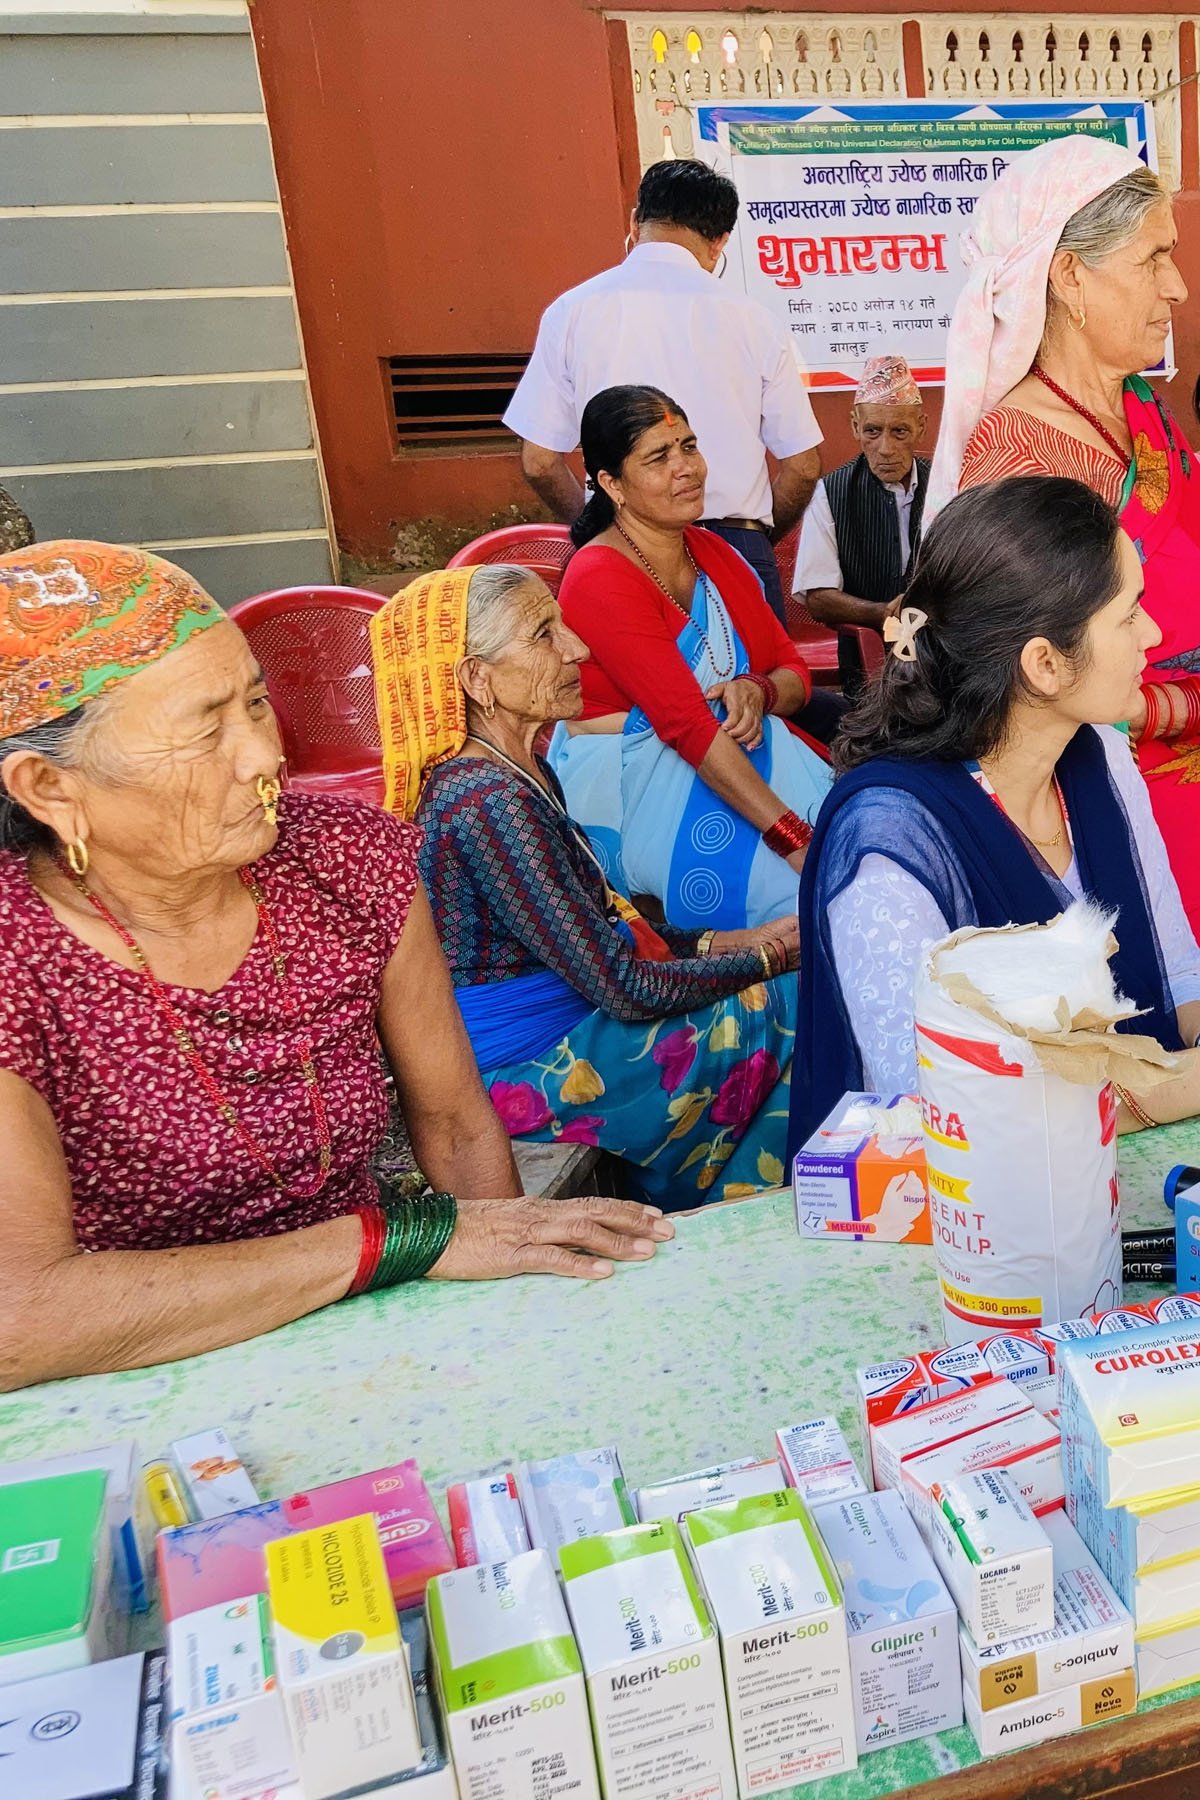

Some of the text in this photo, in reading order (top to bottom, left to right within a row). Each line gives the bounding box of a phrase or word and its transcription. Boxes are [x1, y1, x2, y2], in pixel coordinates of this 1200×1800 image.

[814, 140, 824, 148] Of
[825, 140, 841, 148] The
[842, 139, 878, 148] Universal
[879, 138, 922, 148] Declaration
[933, 138, 961, 147] Human
[962, 138, 986, 148] Rights
[987, 138, 1000, 146] For
[1001, 137, 1015, 146] Old
[887, 160, 927, 184] ज्येष्ठ
[932, 158, 988, 183] नागरिक
[851, 194, 892, 218] ज्येष्ठ
[895, 192, 952, 217] नागरिक
[757, 233, 949, 290] शुभारम्भ
[788, 298, 813, 314] मिति
[797, 1163, 845, 1175] Powdered
[812, 1216, 822, 1228] 7
[830, 1222, 872, 1233] MEDIUM
[954, 1269, 971, 1284] Use
[978, 1301, 998, 1313] 300
[1001, 1303, 1032, 1317] gms.
[937, 1352, 980, 1366] ICIPRO
[1003, 1338, 1023, 1362] ICIPRO
[1086, 1347, 1122, 1361] Vitamin
[1122, 1337, 1171, 1355] B-Complex
[864, 1365, 909, 1381] ICIPRO
[791, 1419, 825, 1434] ICIPRO
[981, 1472, 1007, 1505] LOCARD-50
[850, 1500, 872, 1537] Glipire
[321, 1530, 350, 1607] HICLOZIDE 25
[980, 1564, 1021, 1580] LOCARD-50
[490, 1561, 516, 1611] Merit-500
[749, 1563, 780, 1618] Merit-500
[618, 1596, 648, 1652] Merit-500
[742, 1620, 829, 1656] Merit-500
[871, 1625, 937, 1654] Glipire 1
[1053, 1644, 1120, 1673] Ambloc-5
[205, 1663, 221, 1707] CETRIZ
[611, 1654, 701, 1692] Merit-500
[471, 1691, 566, 1732] Merit-500
[1000, 1707, 1065, 1736] Ambloc-5
[865, 1727, 897, 1742] Aspire
